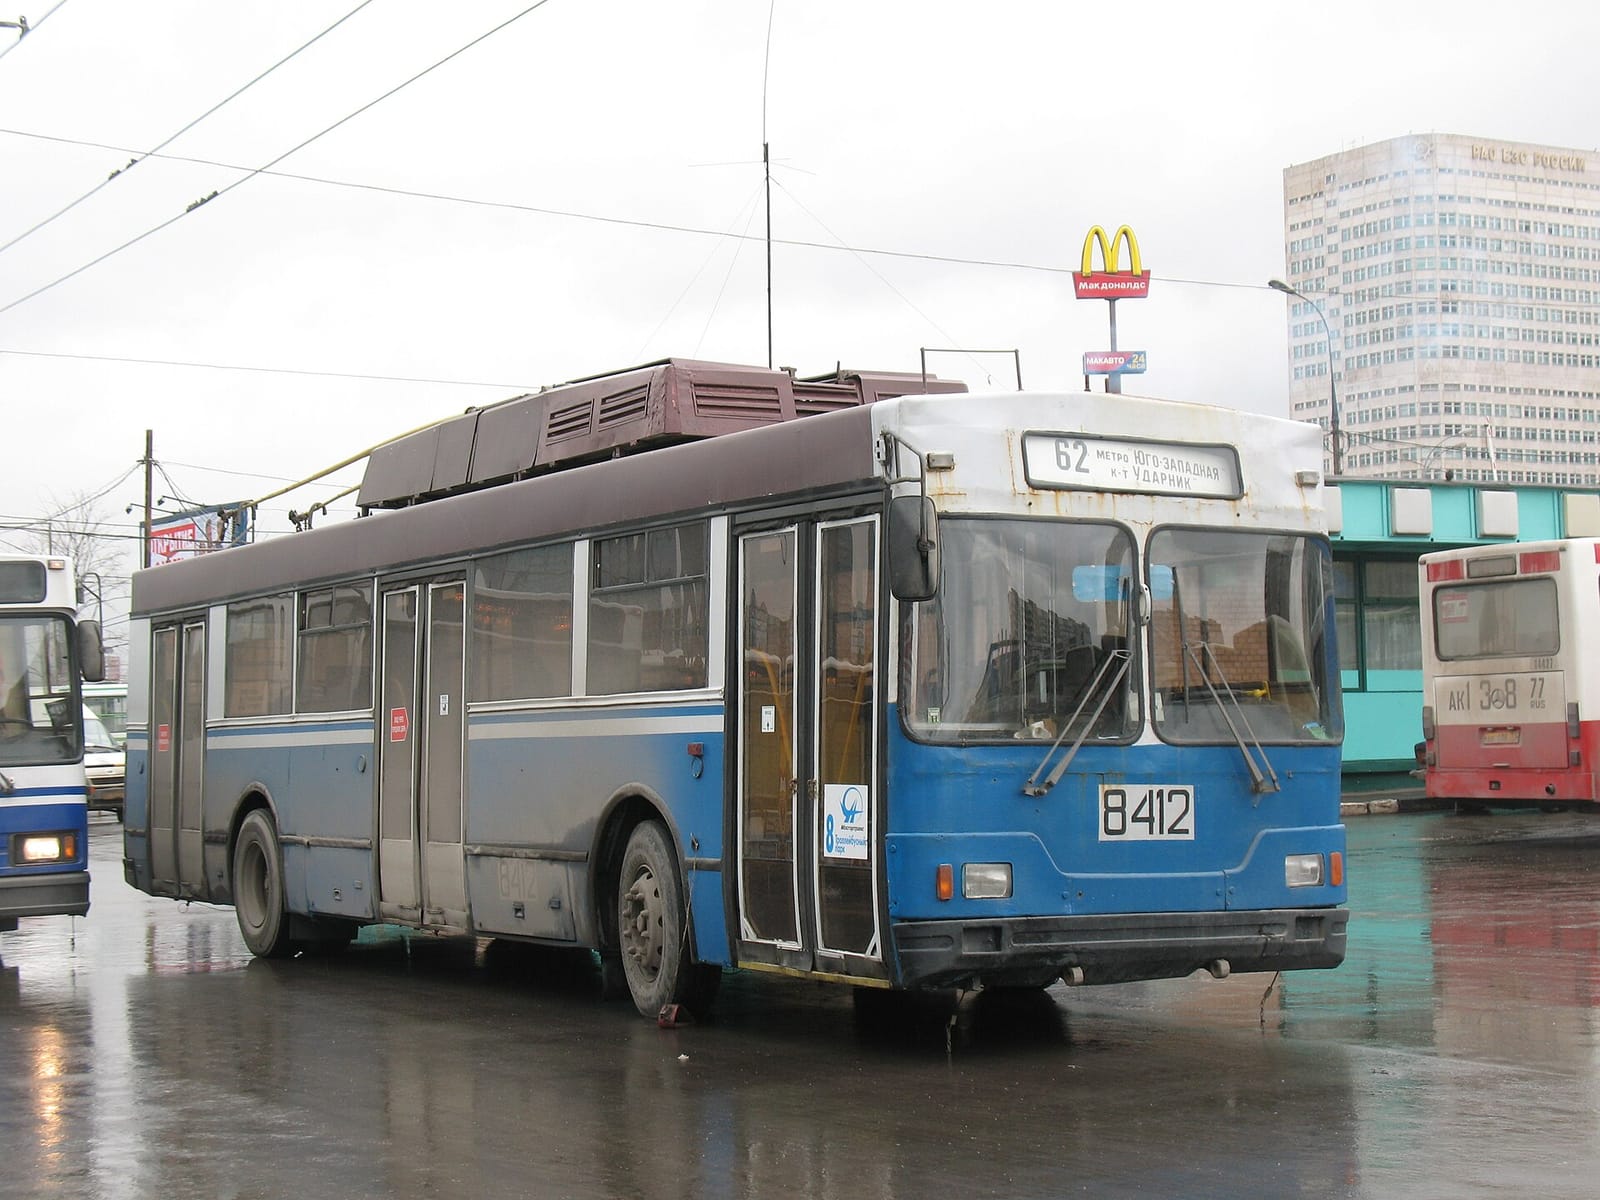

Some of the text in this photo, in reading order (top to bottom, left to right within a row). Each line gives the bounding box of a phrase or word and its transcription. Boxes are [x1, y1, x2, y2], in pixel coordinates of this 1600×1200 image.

[1079, 281, 1146, 291] Макдоналдс
[1086, 356, 1125, 366] МАКАВТО
[1132, 354, 1145, 363] 24
[1054, 438, 1090, 474] 62
[1096, 449, 1220, 481] МЕТРО ЮГО-ЗАПАДНАЯ
[1132, 466, 1192, 490] УДАРНИК
[1530, 677, 1545, 698] 77
[1530, 700, 1546, 709] RUS
[1103, 789, 1190, 835] 8412
[826, 814, 834, 853] 8
